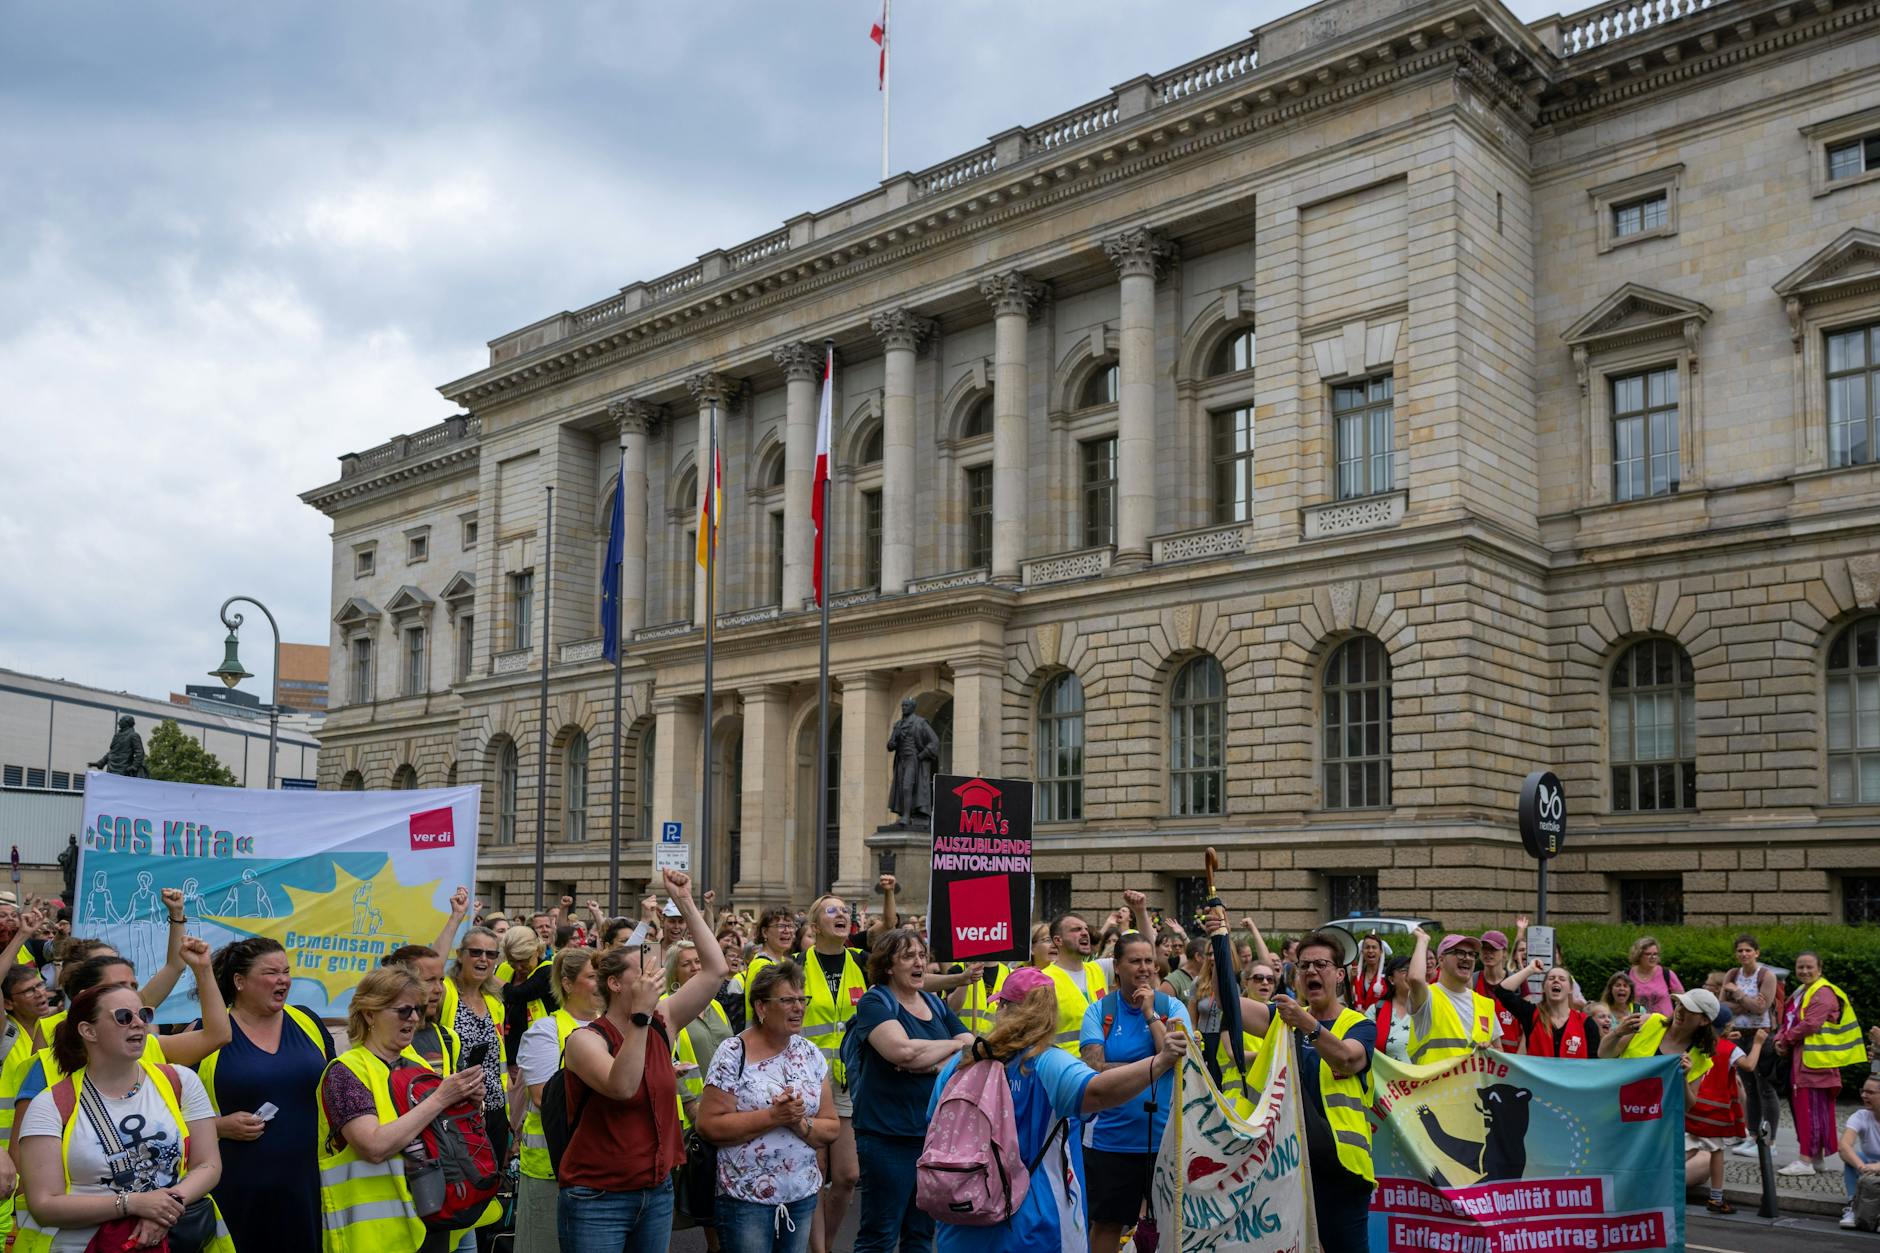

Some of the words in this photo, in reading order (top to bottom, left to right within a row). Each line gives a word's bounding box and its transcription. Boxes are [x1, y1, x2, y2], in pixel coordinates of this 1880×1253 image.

[666, 824, 677, 841] P
[959, 810, 1009, 834] MIA's
[934, 836, 1032, 856] AUSZUBILDENDE
[933, 854, 1031, 873] MENTOR:INNEN
[285, 931, 385, 954] Gemeinsam
[955, 922, 1007, 942] ver.di
[296, 951, 323, 969] für
[327, 954, 368, 973] gute
[1493, 1186, 1552, 1216] Qualität
[1555, 1185, 1593, 1208] und
[1602, 1219, 1656, 1248] jetzt!
